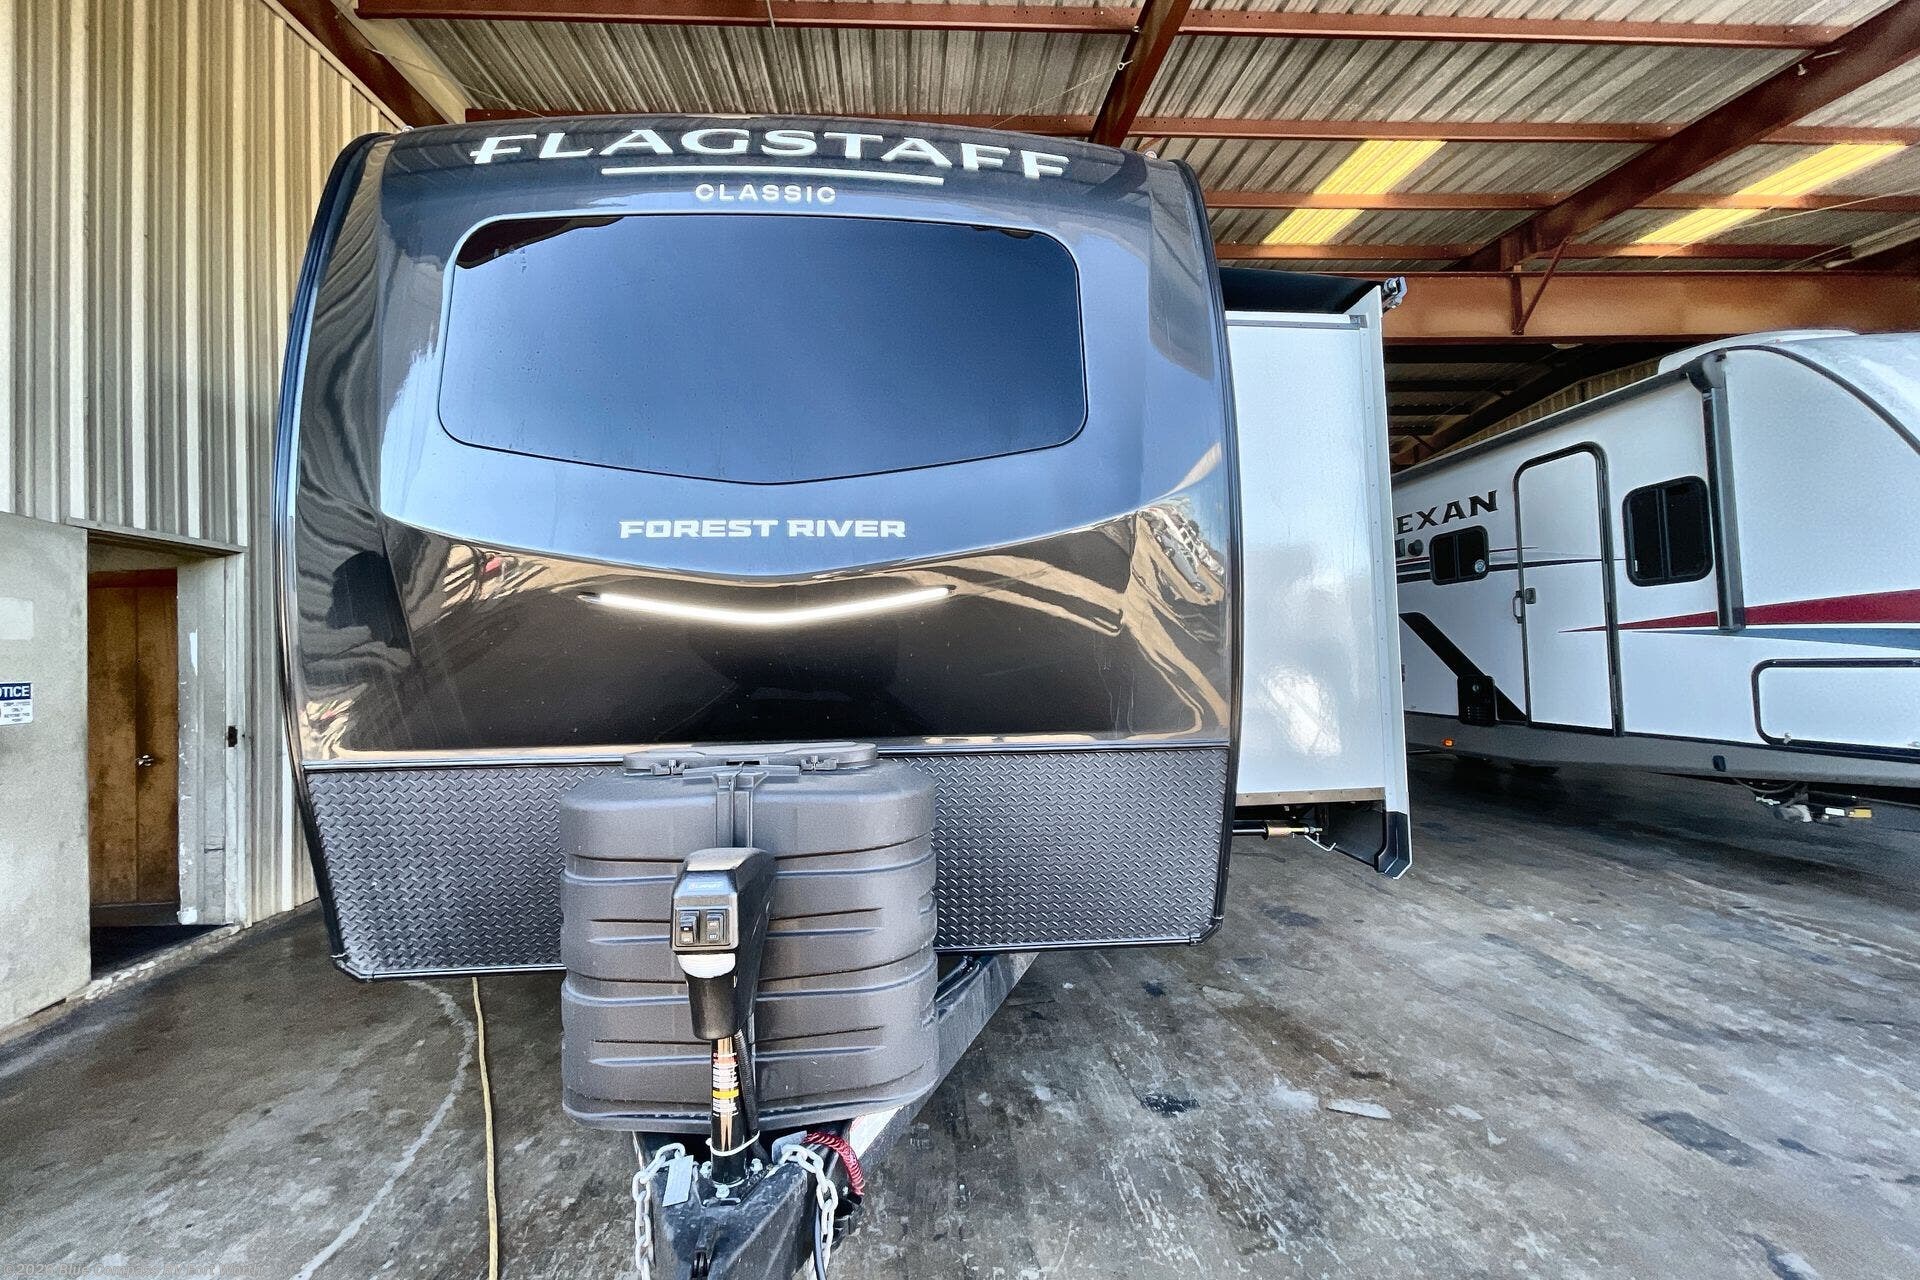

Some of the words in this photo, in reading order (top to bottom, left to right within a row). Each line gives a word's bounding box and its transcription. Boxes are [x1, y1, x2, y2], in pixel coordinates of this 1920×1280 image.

[469, 128, 1070, 179] FLAGSTAFF
[695, 184, 836, 202] CLASSIC
[619, 519, 779, 539] FOREST
[786, 519, 907, 538] RIVER
[0, 685, 30, 698] TICE
